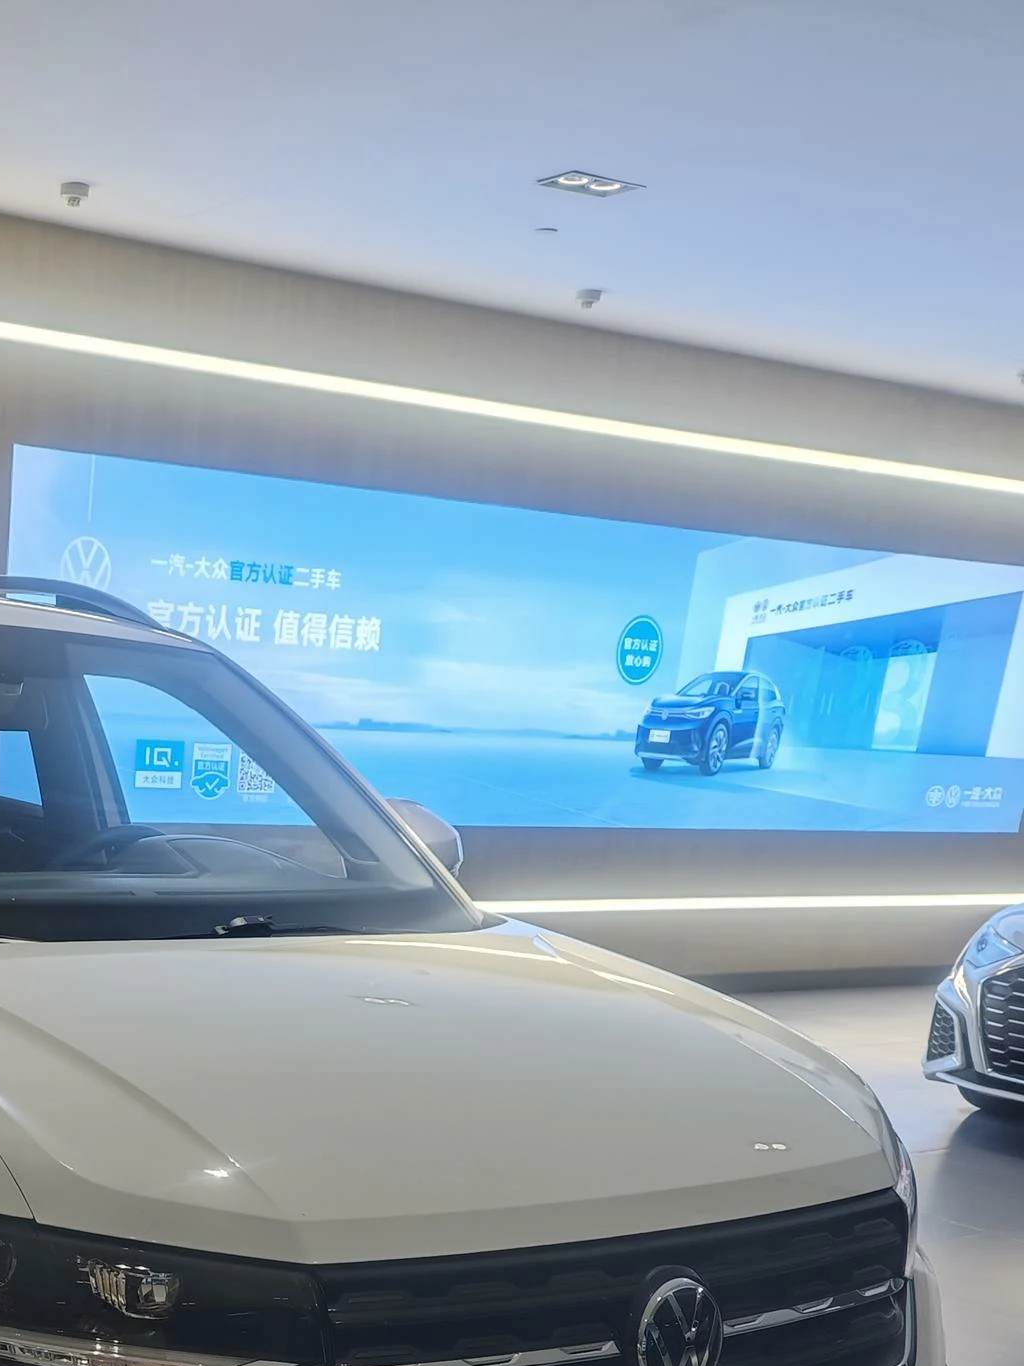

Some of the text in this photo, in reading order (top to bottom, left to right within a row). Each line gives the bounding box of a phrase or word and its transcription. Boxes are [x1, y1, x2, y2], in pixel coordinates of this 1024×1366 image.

[151, 554, 342, 591] 一汽-大众官方认证二手车
[147, 600, 381, 651] 官方认证 值得信赖
